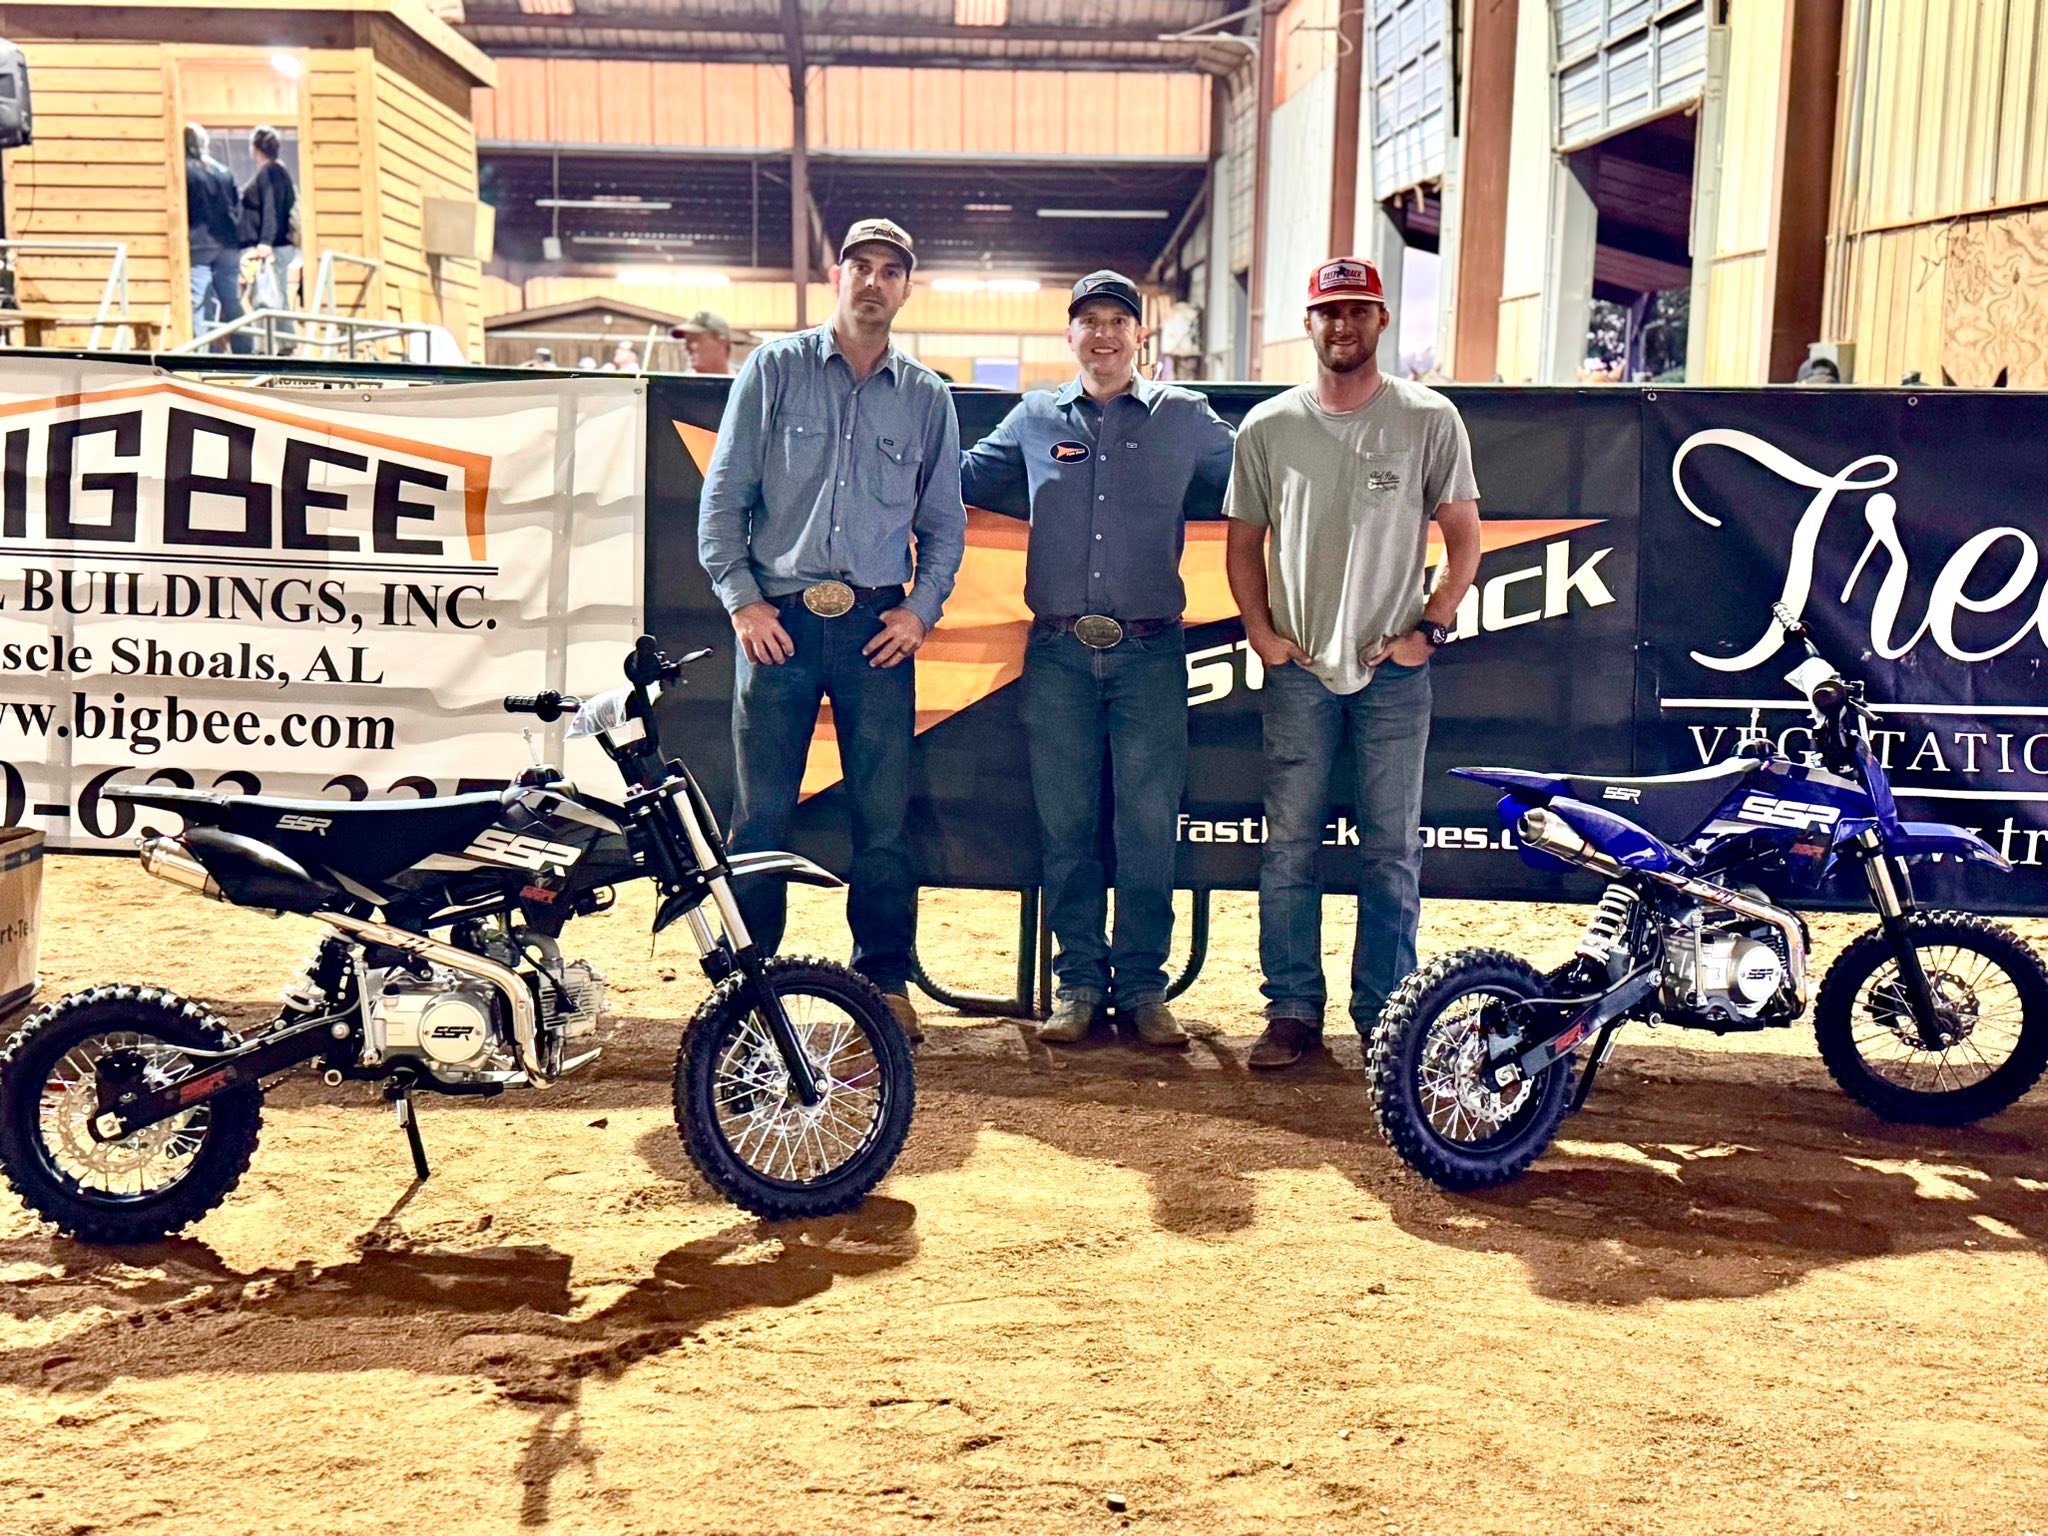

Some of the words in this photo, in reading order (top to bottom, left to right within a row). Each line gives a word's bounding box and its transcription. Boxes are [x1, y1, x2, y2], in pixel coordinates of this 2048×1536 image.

[1672, 428, 2048, 673] Tre
[19, 567, 363, 634] BUILDINGS,
[380, 583, 498, 631] INC.
[3, 635, 93, 673] scle
[111, 636, 290, 690] Shoals,
[301, 646, 384, 684] AL
[0, 691, 396, 754] w.bigbee.com
[1602, 786, 1642, 805] SSR
[1737, 796, 1841, 833] SSR
[275, 814, 333, 837] SSR
[463, 828, 582, 877] SSR
[1746, 968, 1774, 981] SSR
[431, 1025, 475, 1041] SSR
